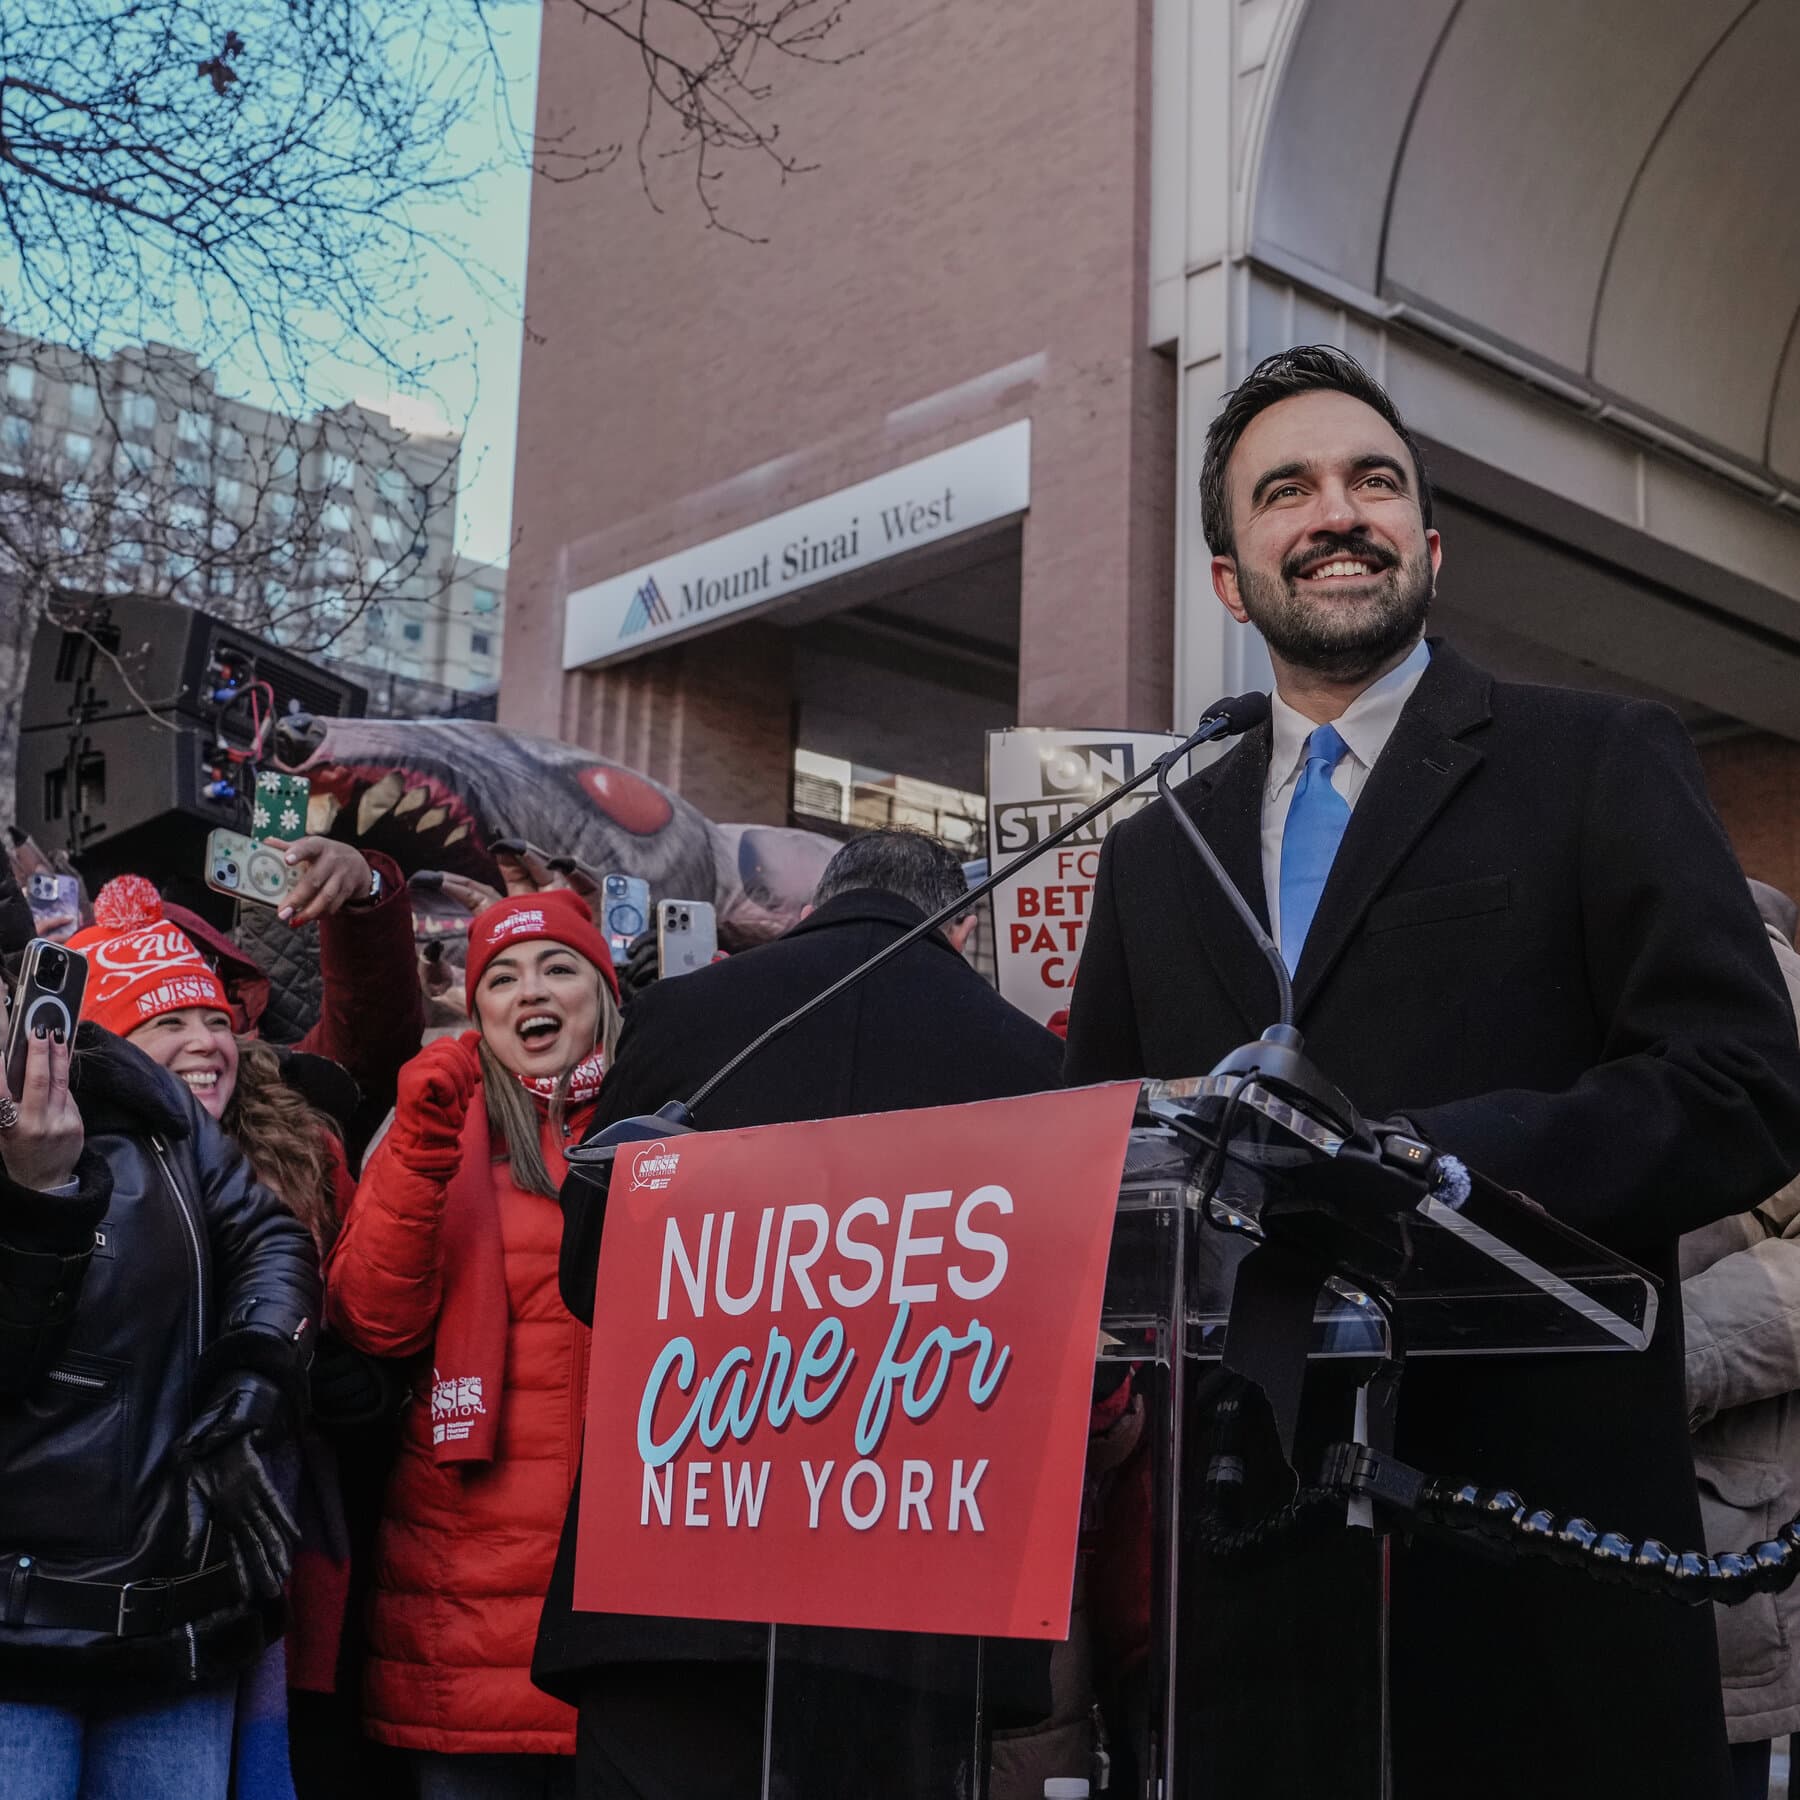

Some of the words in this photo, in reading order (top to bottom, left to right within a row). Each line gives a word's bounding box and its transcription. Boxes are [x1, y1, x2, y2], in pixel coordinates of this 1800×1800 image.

[678, 553, 770, 618] Mount
[780, 517, 860, 582] Sinai
[880, 487, 956, 544] West
[1045, 748, 1127, 796] ON
[1016, 884, 1095, 918] BET
[1010, 920, 1090, 954] PAT
[136, 981, 217, 1015] NURSES
[656, 1184, 1015, 1321] NURSES
[636, 1316, 857, 1468] Care
[854, 1299, 1011, 1457] for
[640, 1459, 772, 1529] NEW
[801, 1458, 990, 1533] YORK
